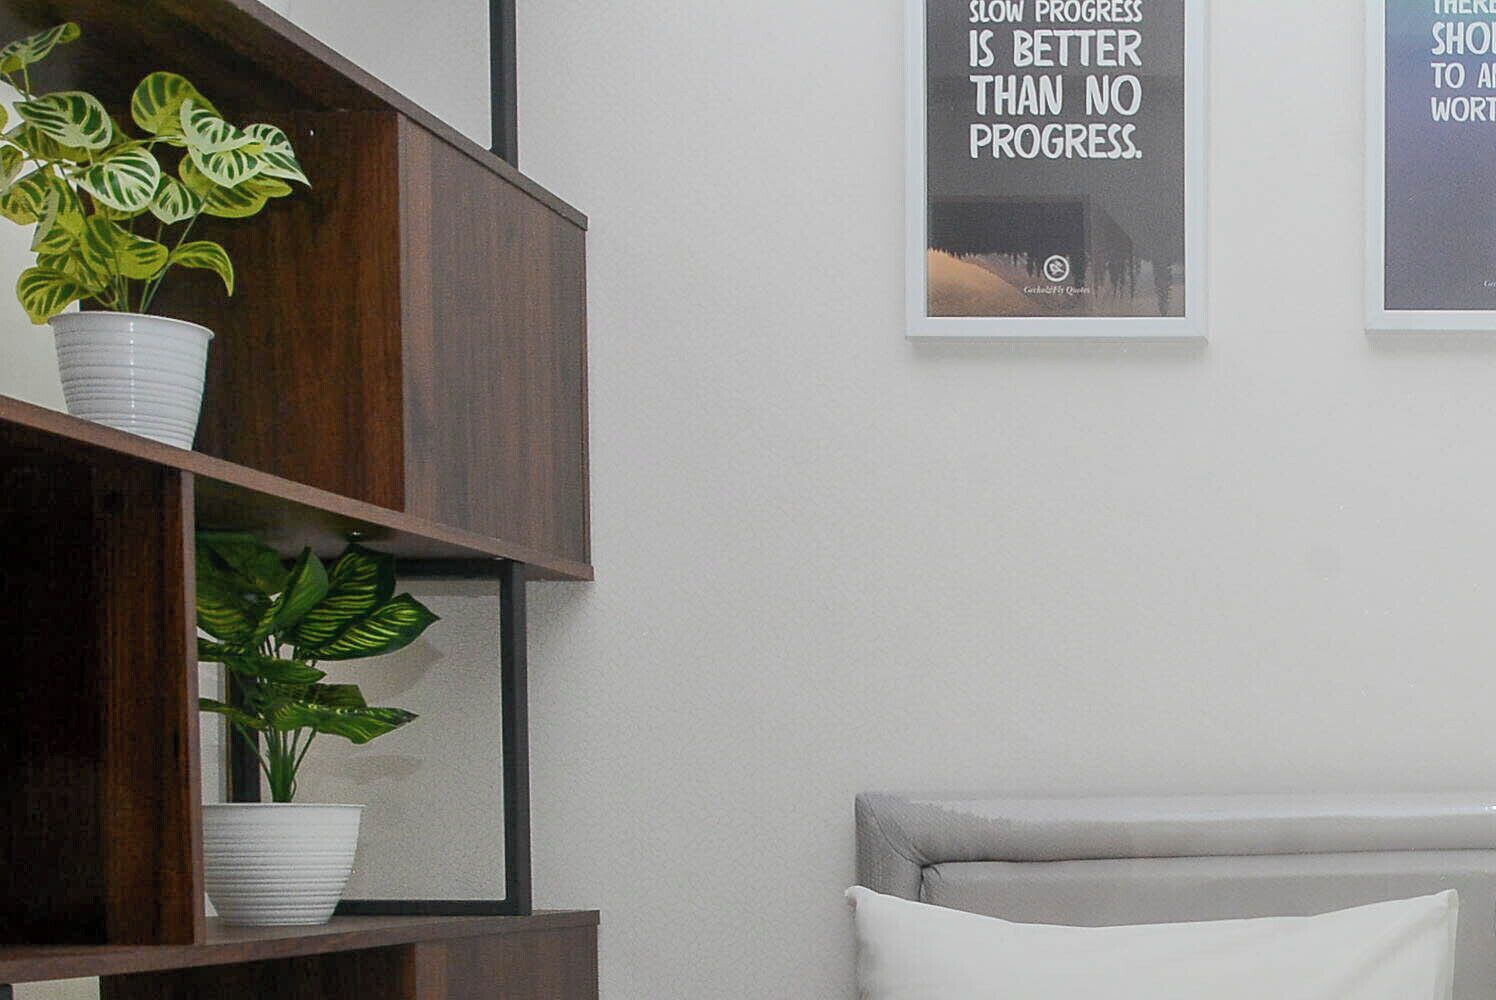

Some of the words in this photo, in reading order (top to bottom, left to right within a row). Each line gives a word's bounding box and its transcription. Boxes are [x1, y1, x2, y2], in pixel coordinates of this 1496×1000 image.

[969, 0, 1024, 22] SLOW
[1035, 0, 1142, 22] PROGRESS
[969, 29, 995, 67] IS
[1013, 29, 1142, 67] BETTER
[1431, 62, 1465, 89] TO
[969, 74, 1063, 115] THAN
[1086, 74, 1142, 115] NO
[969, 123, 1142, 159] PROGRESS.
